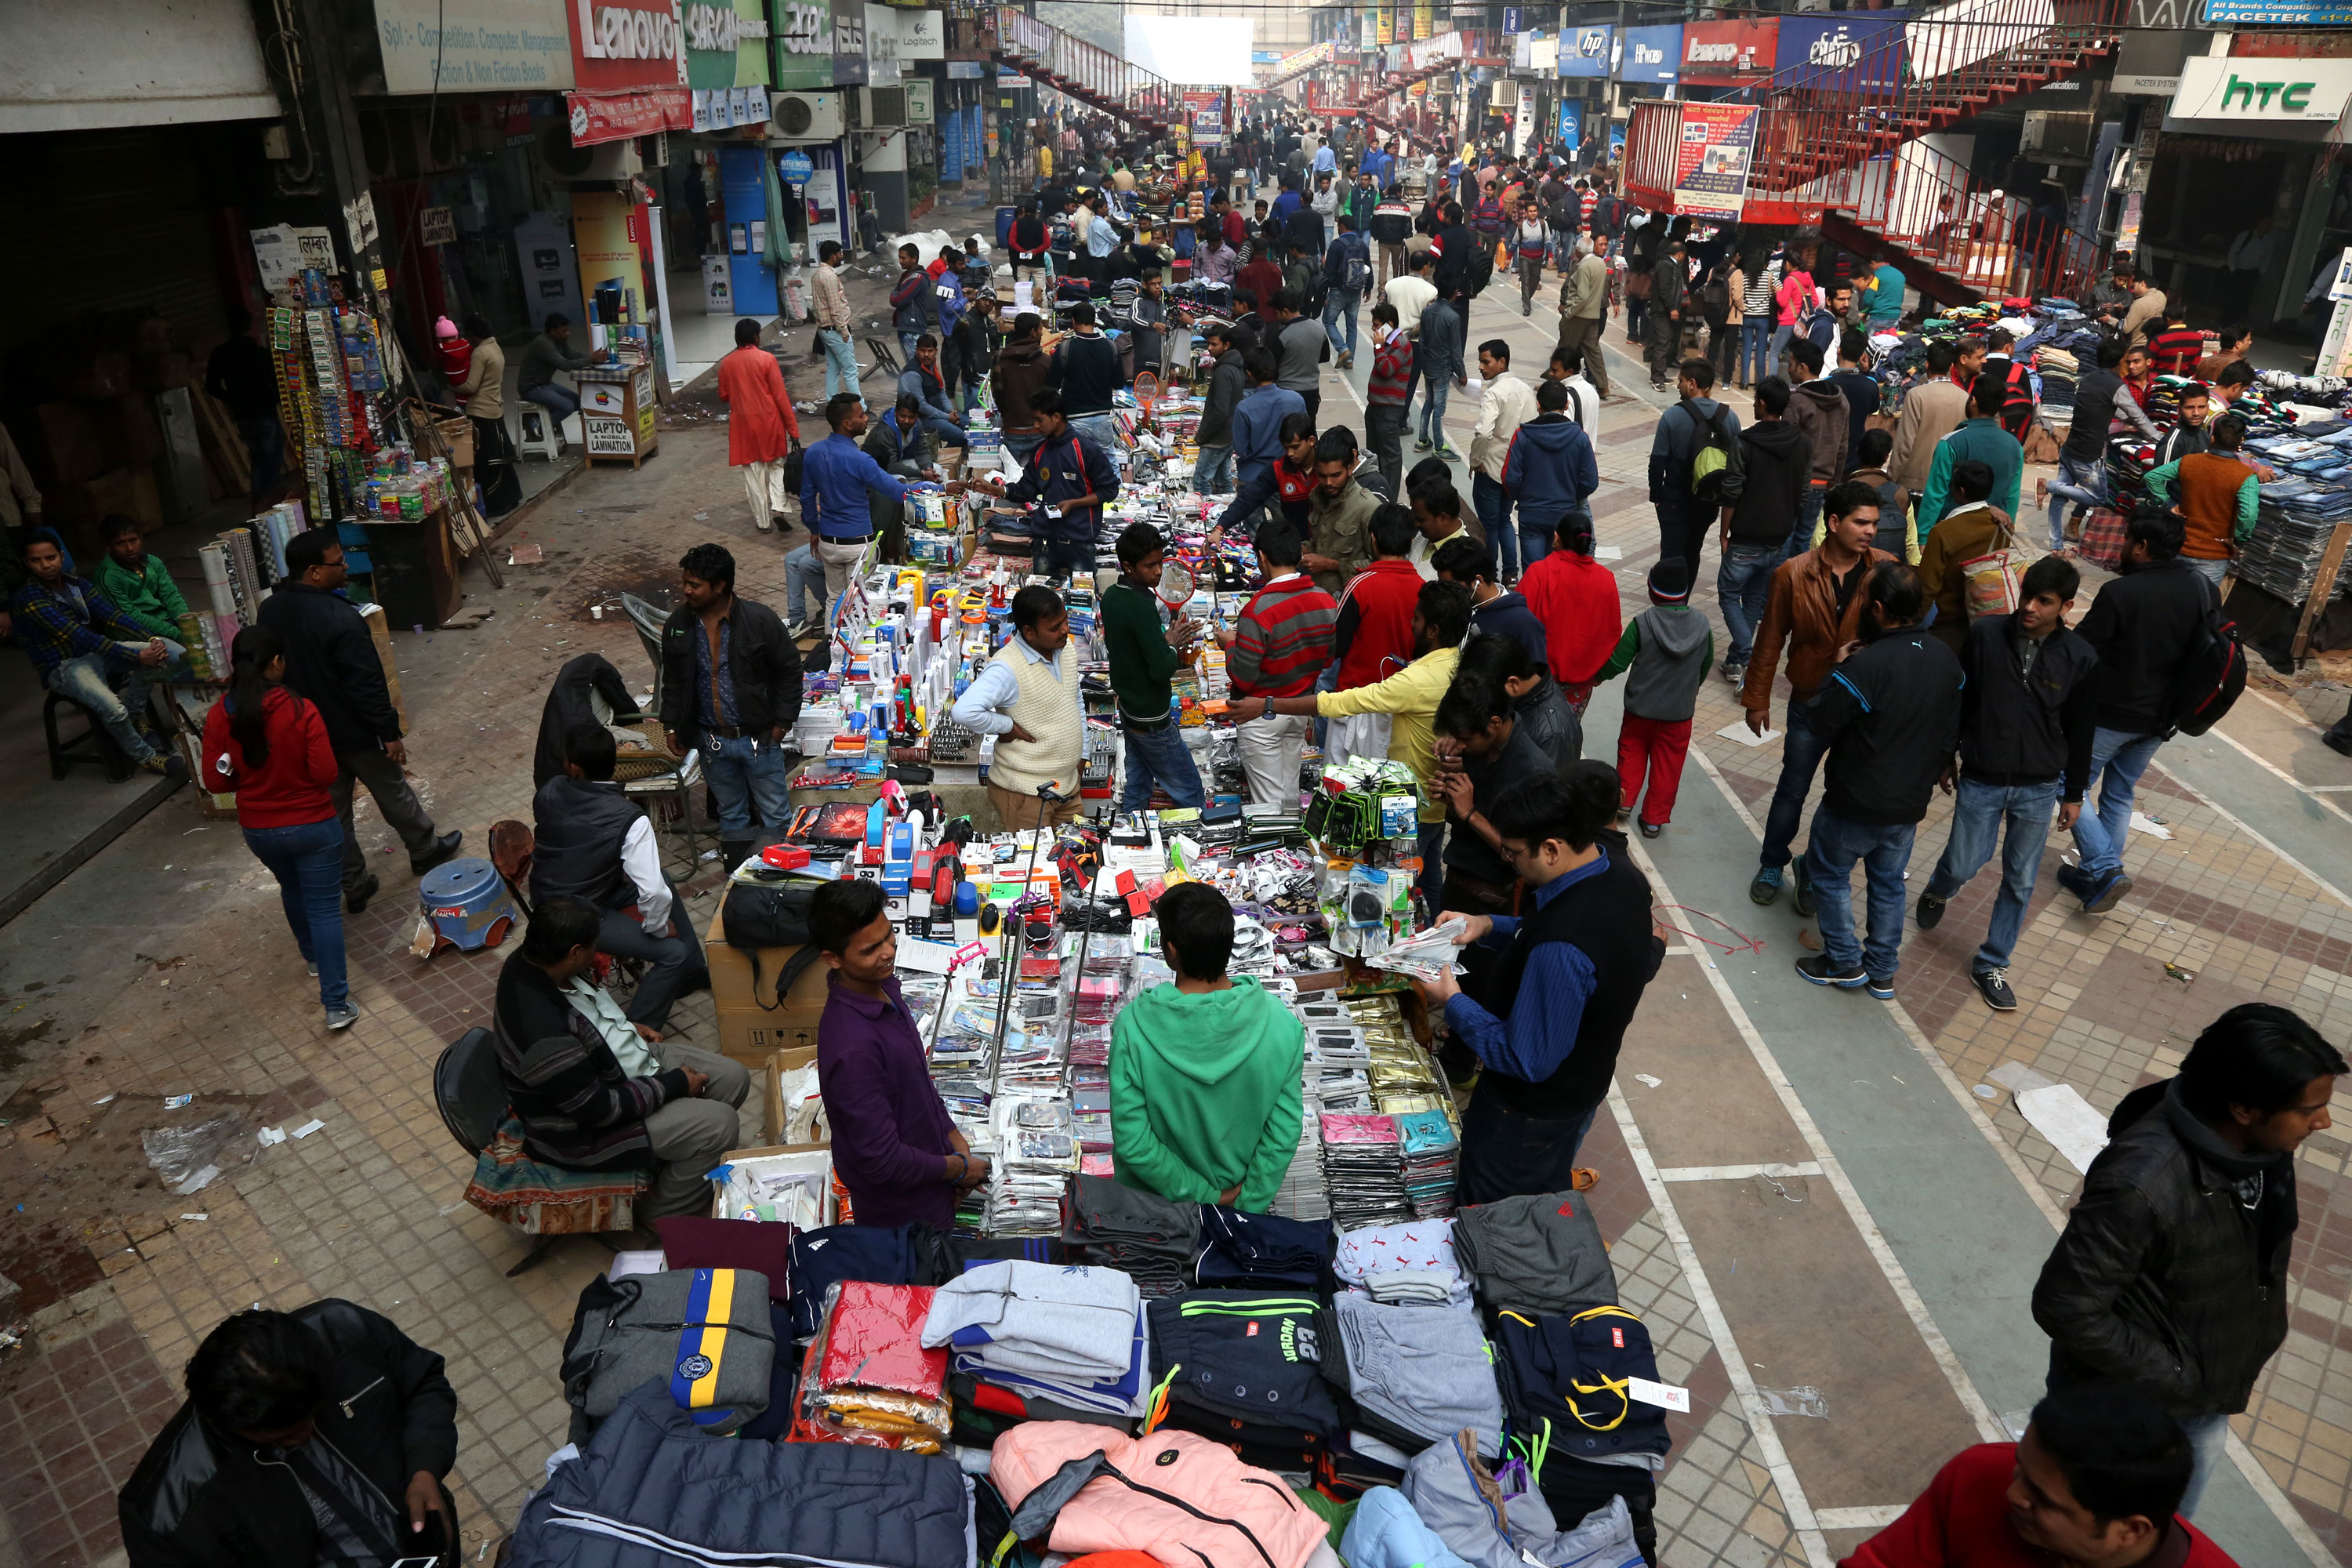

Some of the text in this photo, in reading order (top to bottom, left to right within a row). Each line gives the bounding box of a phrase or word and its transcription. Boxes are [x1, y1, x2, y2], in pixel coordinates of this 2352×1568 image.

[2210, 12, 2311, 23] PACETEK
[383, 20, 402, 52] Spl
[578, 0, 676, 60] Lenovo
[903, 37, 938, 47] Logitech
[1582, 30, 1603, 56] hp
[1635, 43, 1645, 64] HP
[1687, 38, 1737, 62] lenovo
[466, 61, 474, 84] &
[474, 60, 492, 83] Non
[493, 60, 521, 83] Fiction
[522, 60, 546, 82] Books
[2134, 79, 2156, 88] PACETEK
[2221, 74, 2317, 109] htc
[424, 212, 448, 227] LAPTOP
[424, 227, 453, 243] LAMINATION
[2331, 303, 2350, 341] htc
[635, 371, 651, 389] LAPTOP
[591, 440, 632, 452] LAMINATION
[1279, 1317, 1299, 1363] JORDAN
[1297, 1325, 1322, 1363] 23
